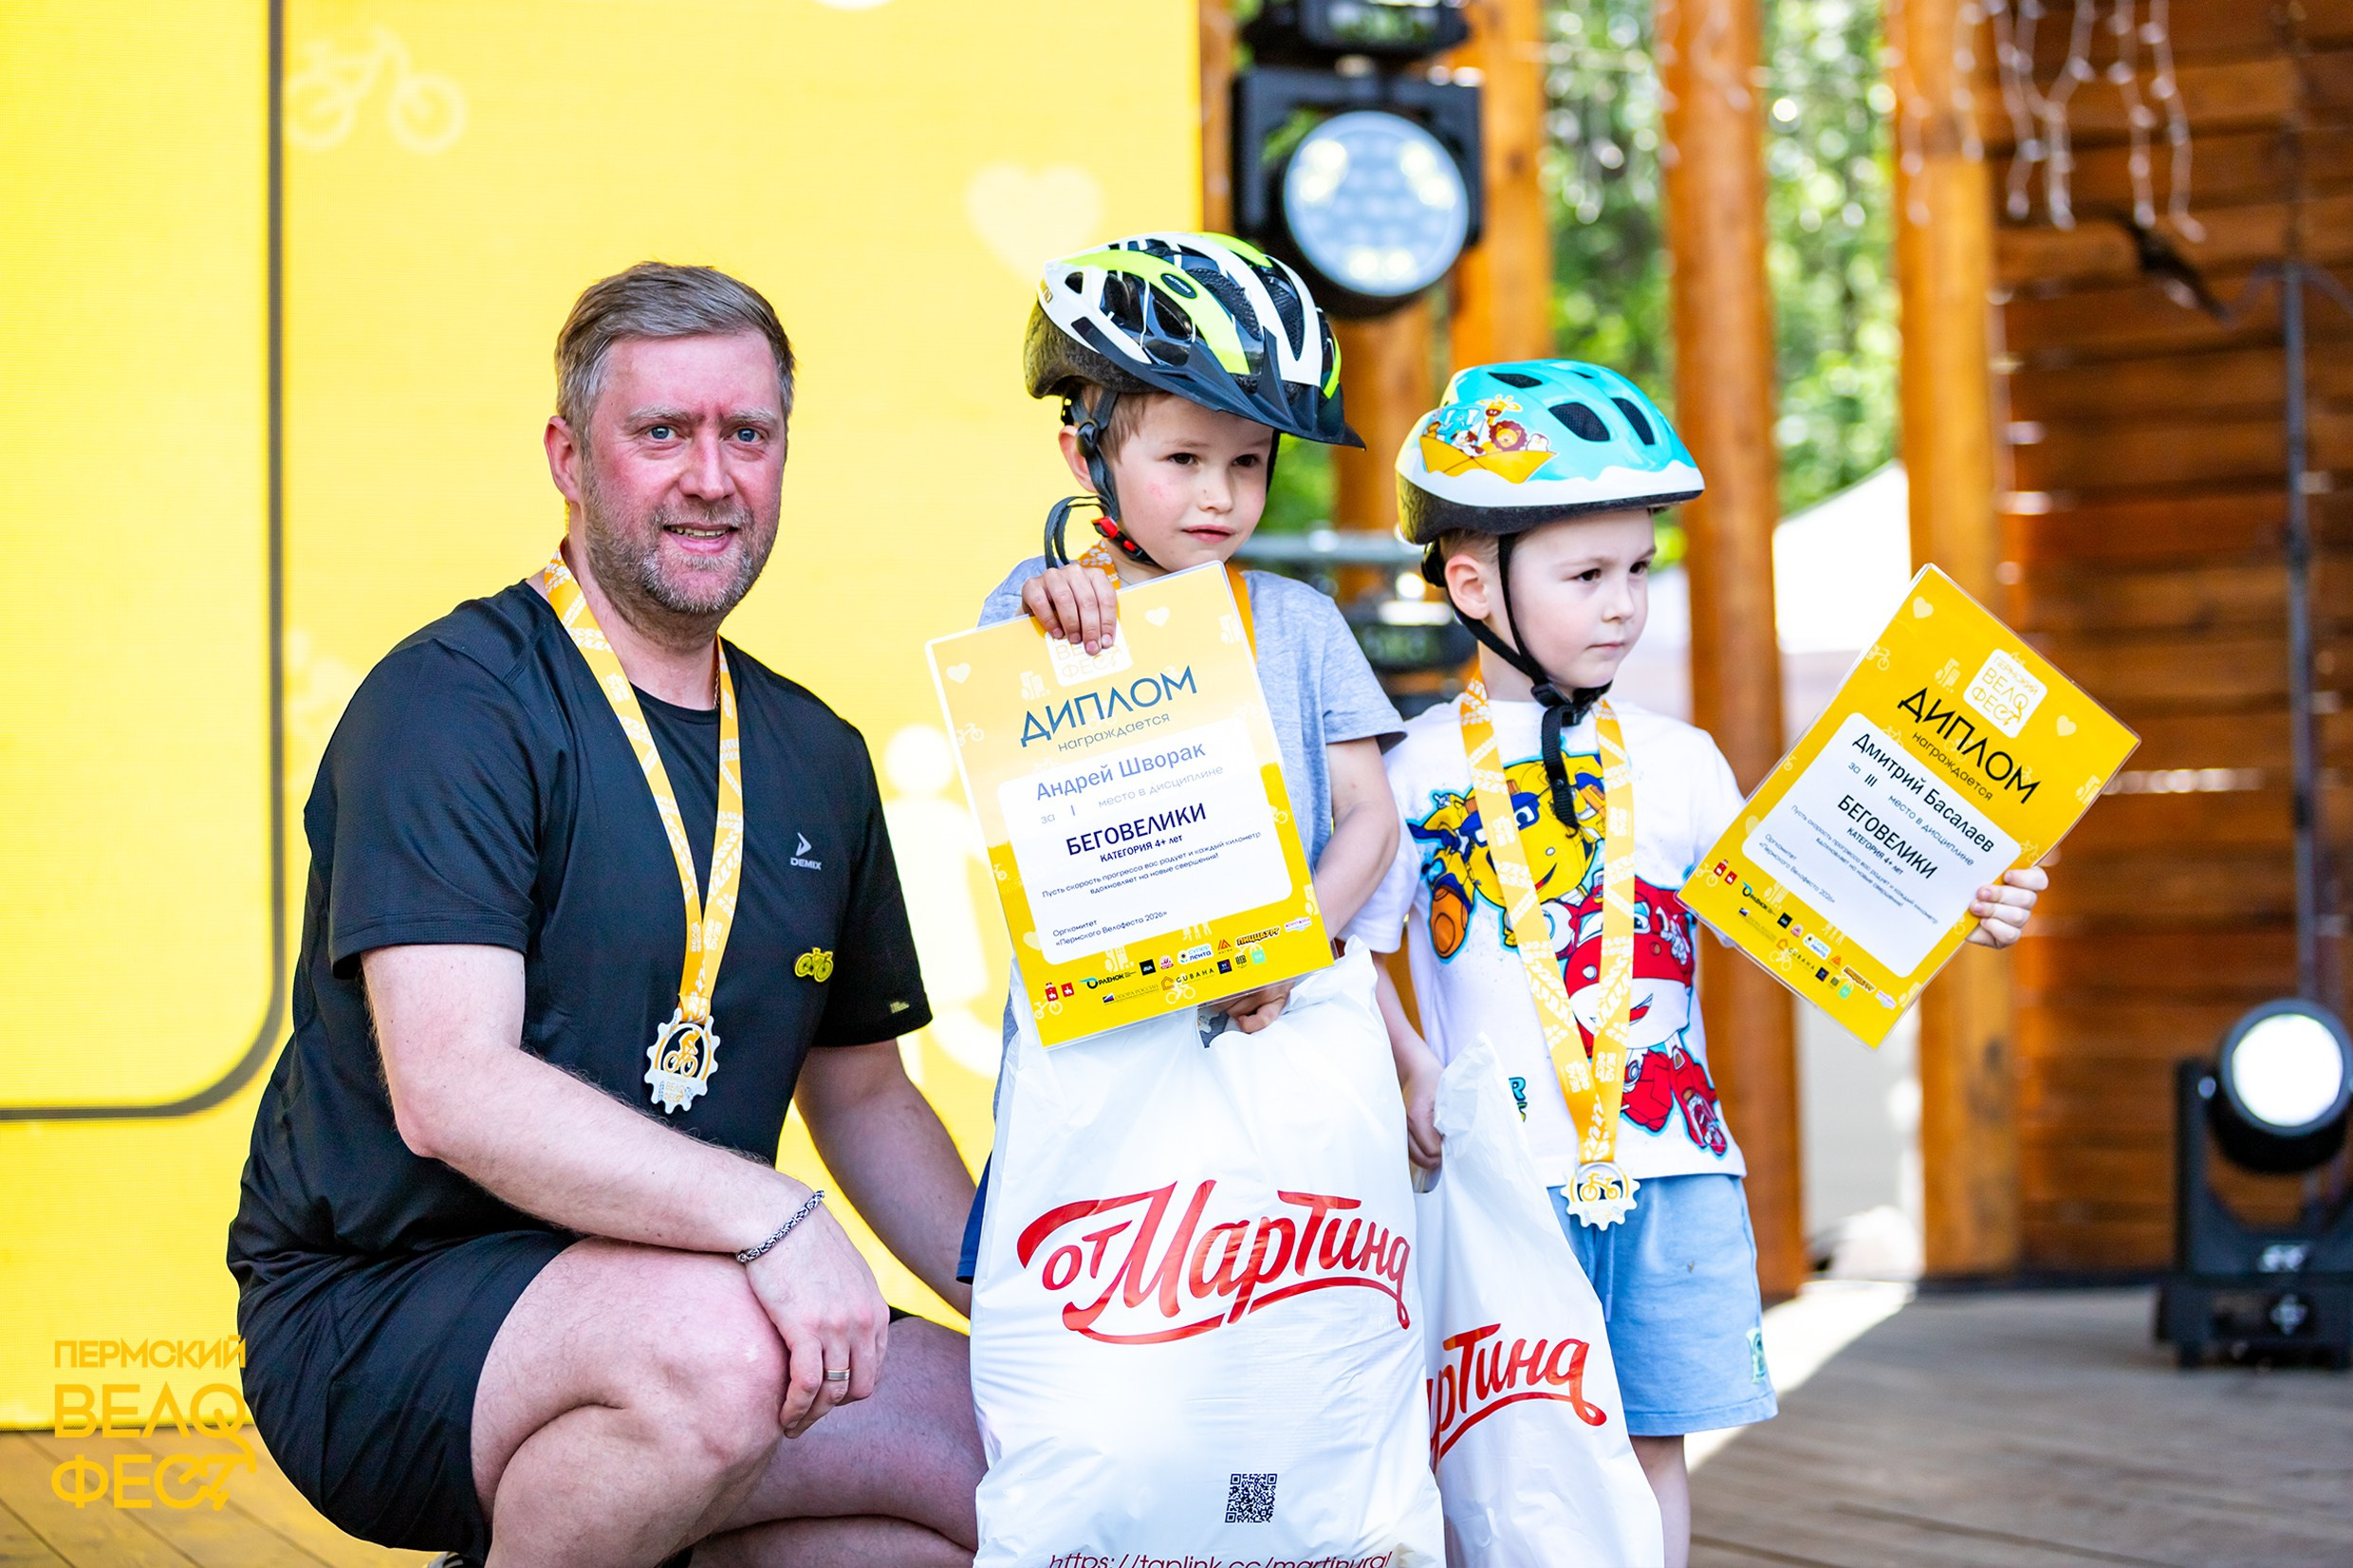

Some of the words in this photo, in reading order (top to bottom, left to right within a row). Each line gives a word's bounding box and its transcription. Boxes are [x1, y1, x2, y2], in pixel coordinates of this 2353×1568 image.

[1020, 665, 1197, 747] ДИПЛОМ
[1982, 667, 2029, 713] ВЕЛО
[1058, 713, 1170, 751] награждается
[1898, 688, 2041, 804] ДИПЛОМ
[1037, 764, 1114, 801] Андрей
[1119, 744, 1206, 778] Шворак
[1041, 813, 1055, 824] за
[1098, 792, 1136, 808] место
[1139, 788, 1146, 797] в
[1149, 766, 1224, 795] дисциплине
[1852, 733, 1926, 795] Дмитрий
[1924, 788, 1994, 853] Басалаев
[1913, 732, 1992, 801] награждается
[1065, 802, 1207, 856] БЕГОВЕЛИКИ
[1838, 795, 1937, 879] БЕГОВЕЛИКИ
[1848, 762, 1862, 774] за
[1888, 795, 1917, 820] место
[1921, 824, 1974, 866] дисциплине
[790, 857, 822, 870] DEMIX
[1042, 886, 1065, 899] Пусть
[1065, 876, 1102, 893] скорость
[1102, 864, 1143, 881] прогресса
[1144, 860, 1158, 869] вас
[1159, 853, 1187, 867] радует
[1195, 841, 1224, 855] каждый
[1225, 831, 1262, 846] километр
[1090, 876, 1138, 895] вдохновляет
[1150, 866, 1174, 877] новые
[1175, 852, 1219, 872] свершения!
[1100, 841, 1153, 863] КАТЕГОРИЯ
[1155, 839, 1167, 847] 4+
[1169, 835, 1183, 844] лет
[1846, 827, 1885, 859] КАТЕГОРИЯ
[1883, 855, 1894, 866] 4+
[1891, 865, 1904, 876] лет
[1052, 919, 1098, 938] Оргкомитет
[1102, 916, 1144, 934] Велофеста
[1427, 1323, 1606, 1473] ртина
